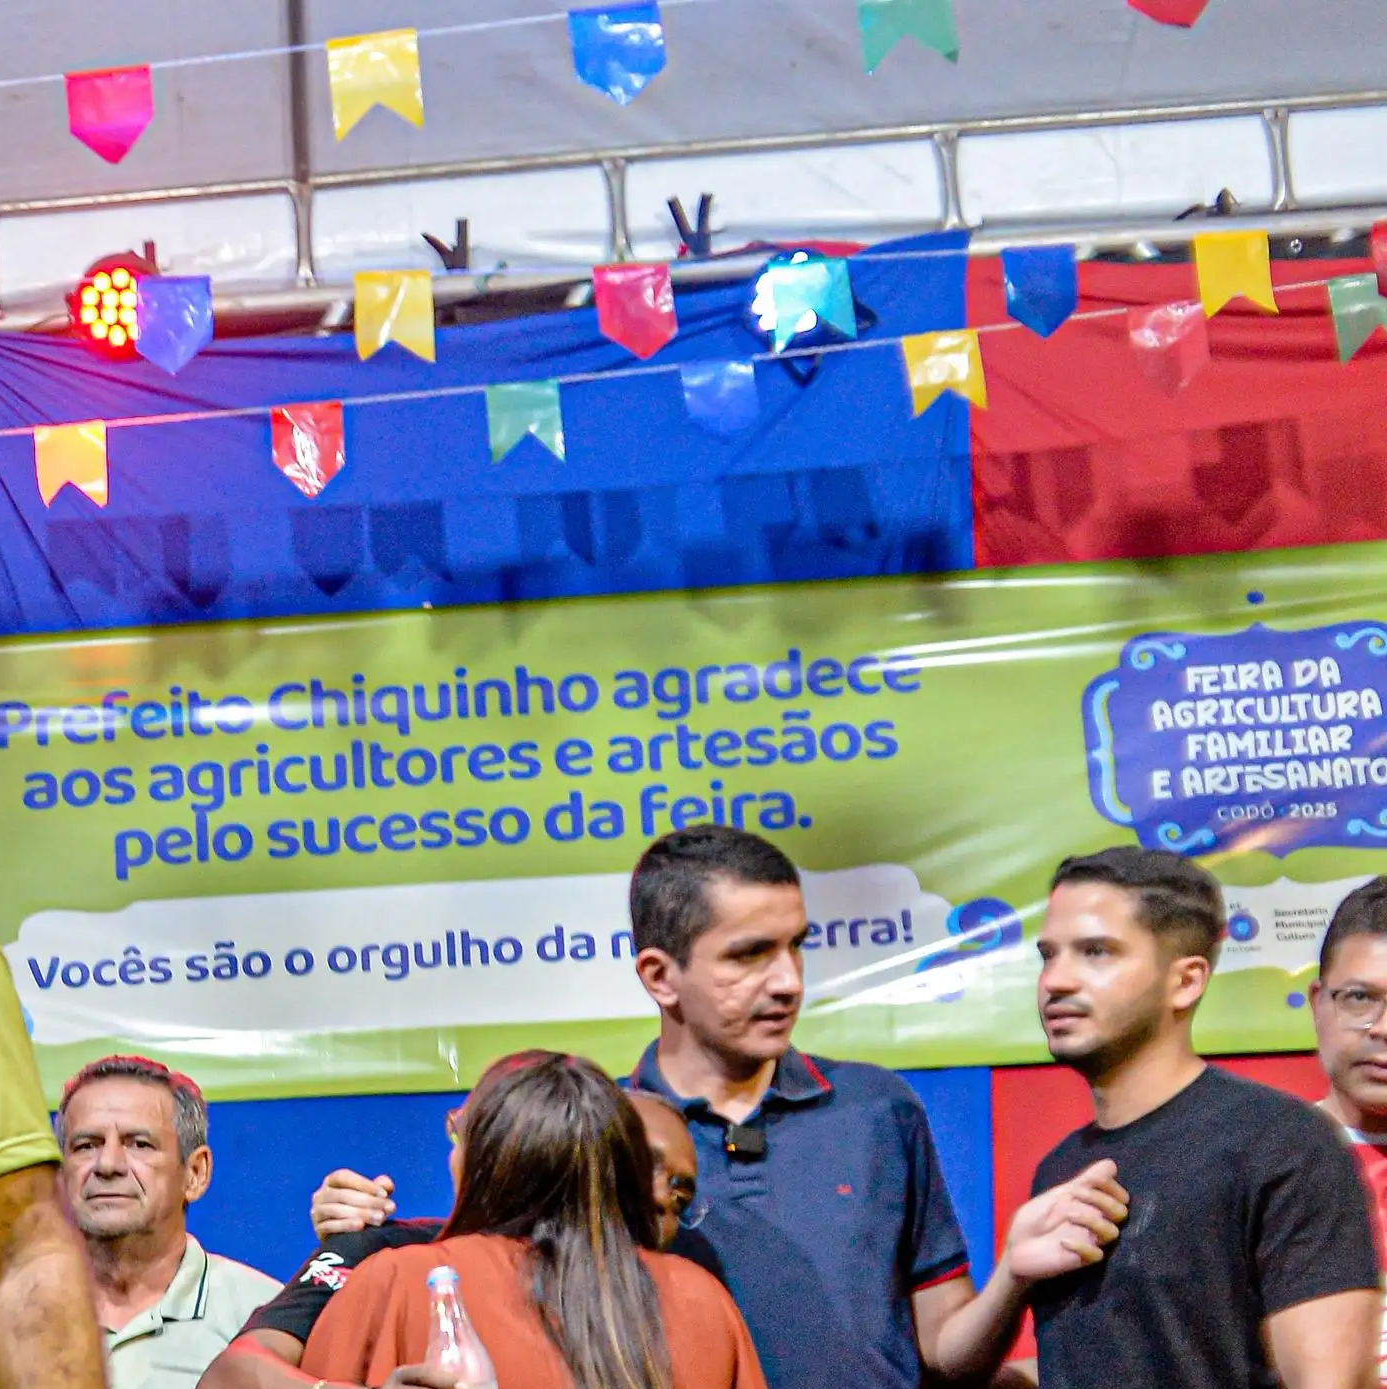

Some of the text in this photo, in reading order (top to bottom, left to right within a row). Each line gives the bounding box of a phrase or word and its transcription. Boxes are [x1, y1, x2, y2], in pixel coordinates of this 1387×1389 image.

[267, 665, 599, 736] Chiquinho
[613, 648, 922, 720] agradece
[1185, 656, 1342, 694] FEIRA DA
[1151, 688, 1384, 731] AGRICULTURA
[22, 709, 899, 813] aos agricultores e artesãos
[1186, 724, 1354, 762] FAMILIAR
[1151, 756, 1387, 799] E ARTESANATO
[113, 779, 813, 881] pelo sucesso da feira.
[1289, 802, 1338, 819] 2025
[27, 945, 173, 990] Vocês
[185, 940, 272, 983] são
[283, 947, 315, 977] o
[327, 929, 523, 981] orgulho
[535, 924, 597, 963] da
[802, 909, 914, 950] erra!
